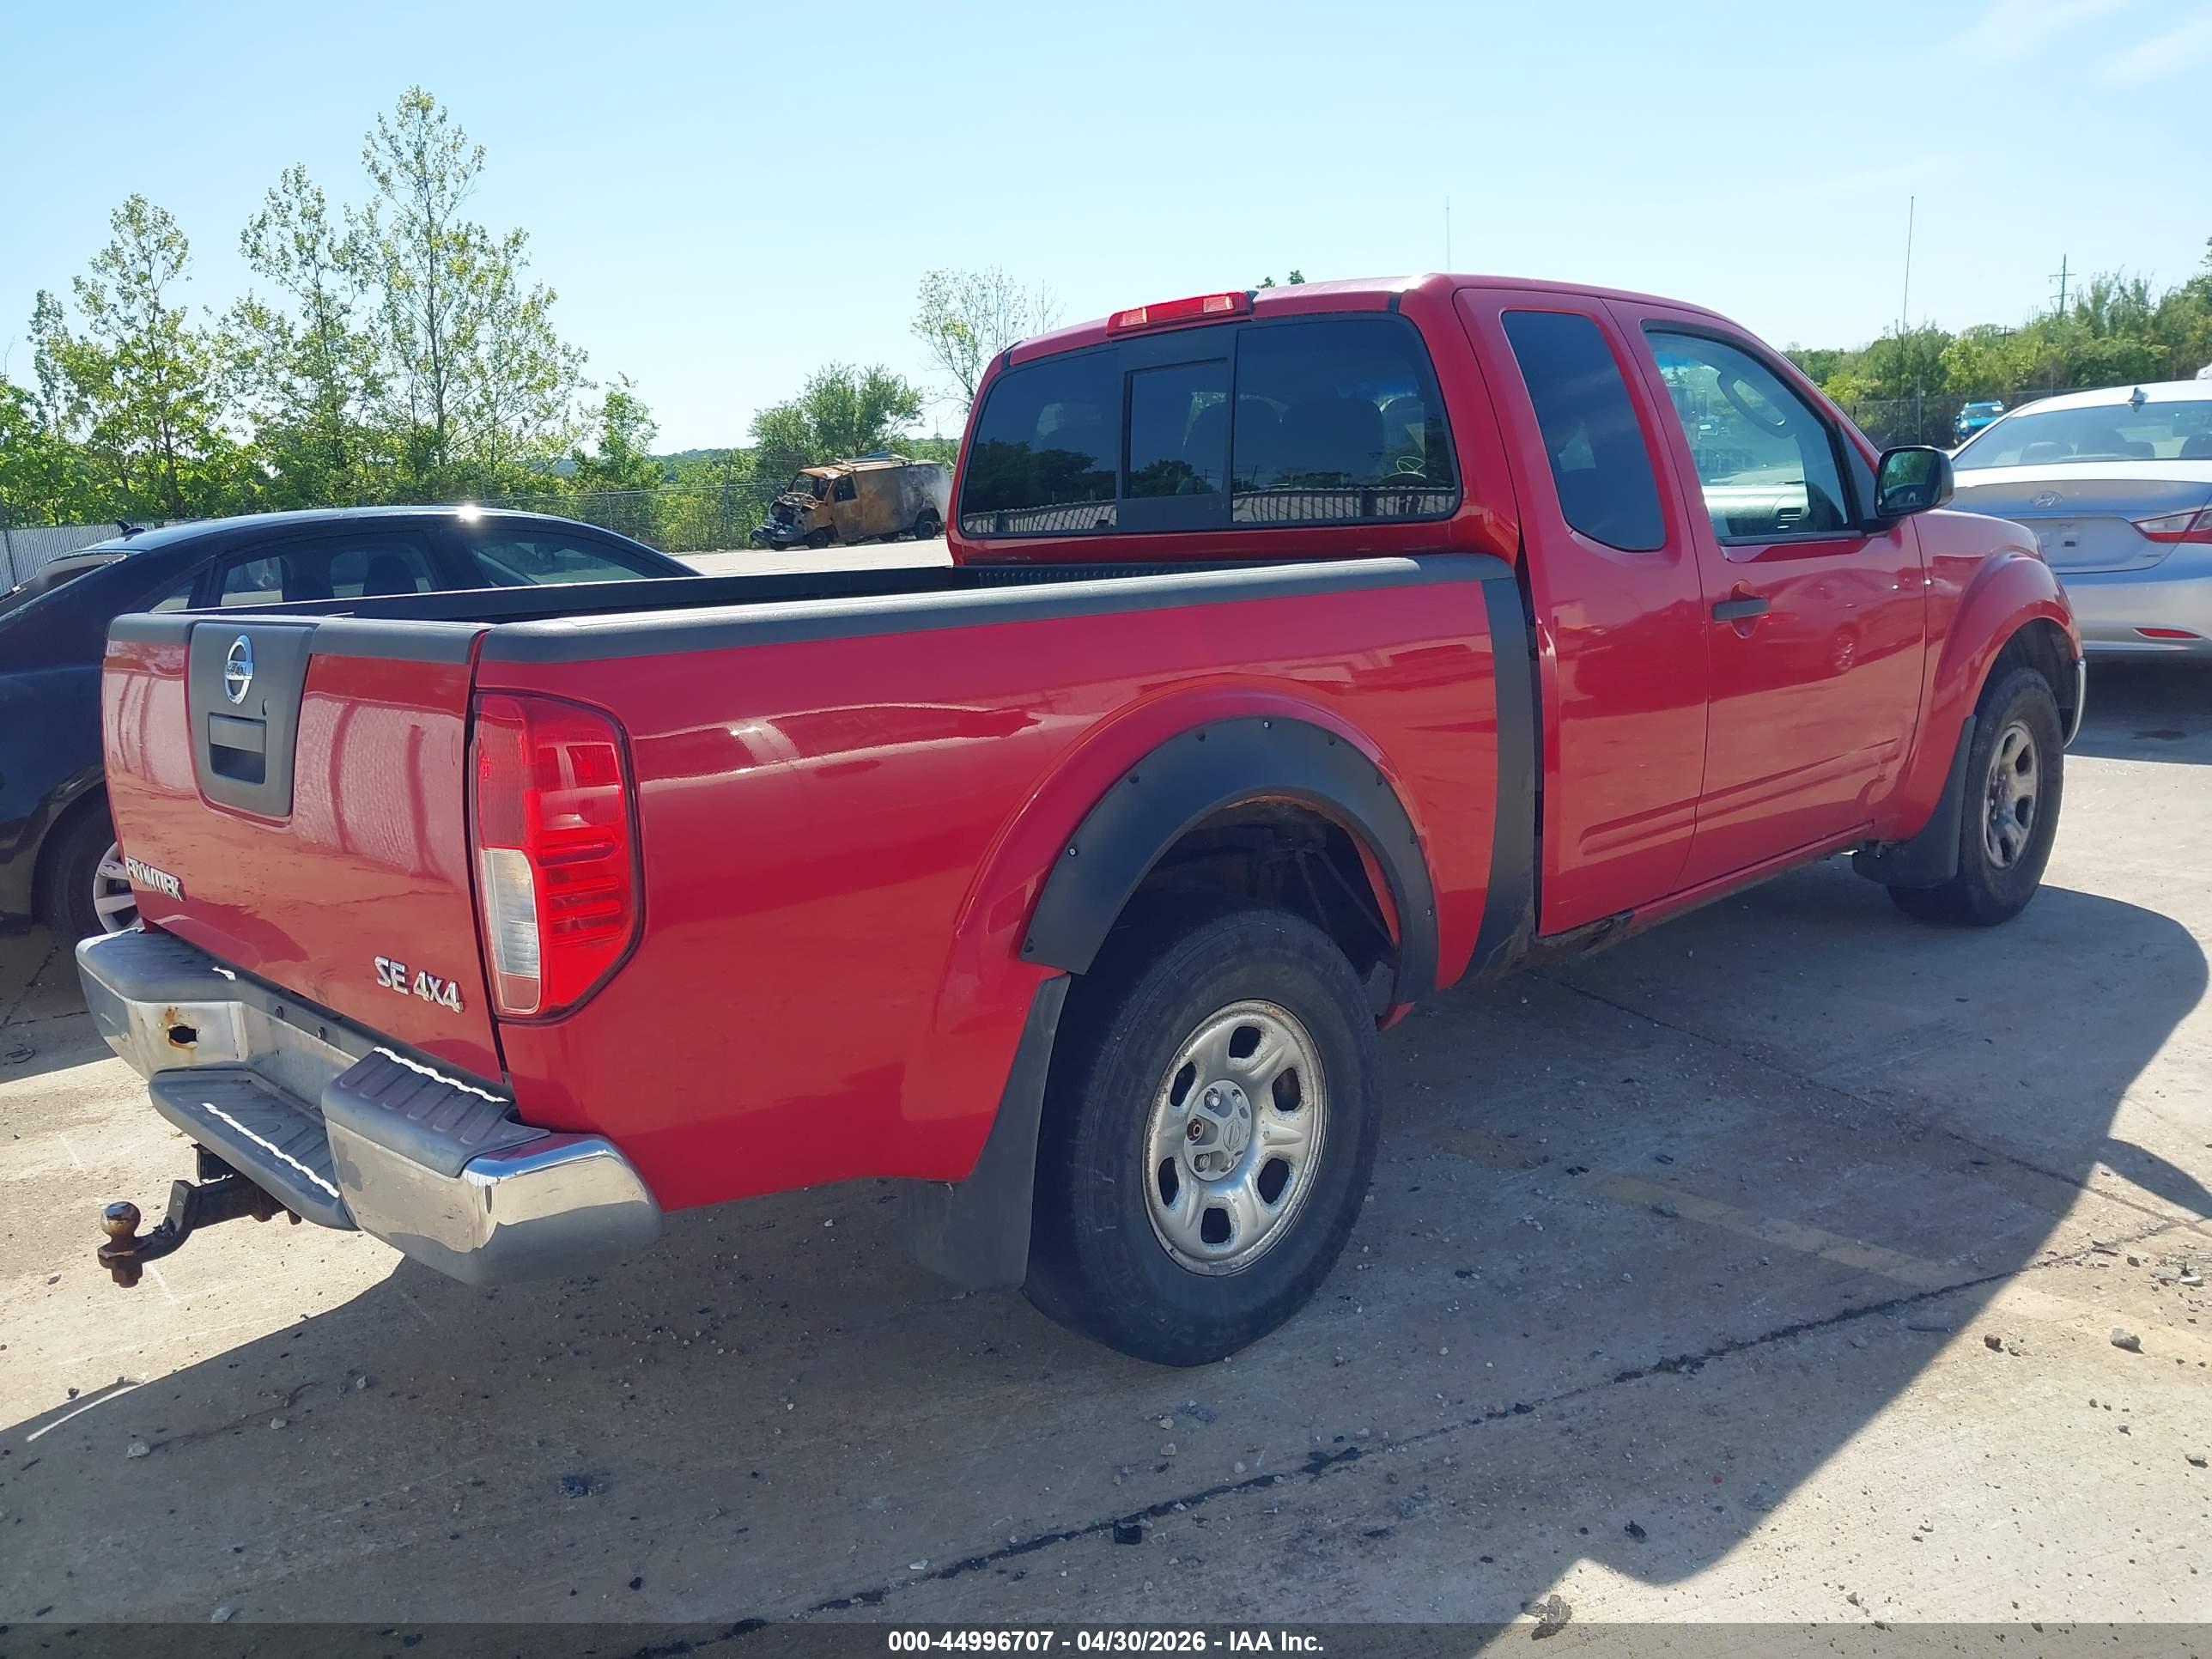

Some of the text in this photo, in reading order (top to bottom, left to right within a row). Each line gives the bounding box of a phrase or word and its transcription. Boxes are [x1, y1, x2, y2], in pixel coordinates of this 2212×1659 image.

[125, 857, 185, 902] FRONTIER
[374, 956, 464, 1013] SE 4X4
